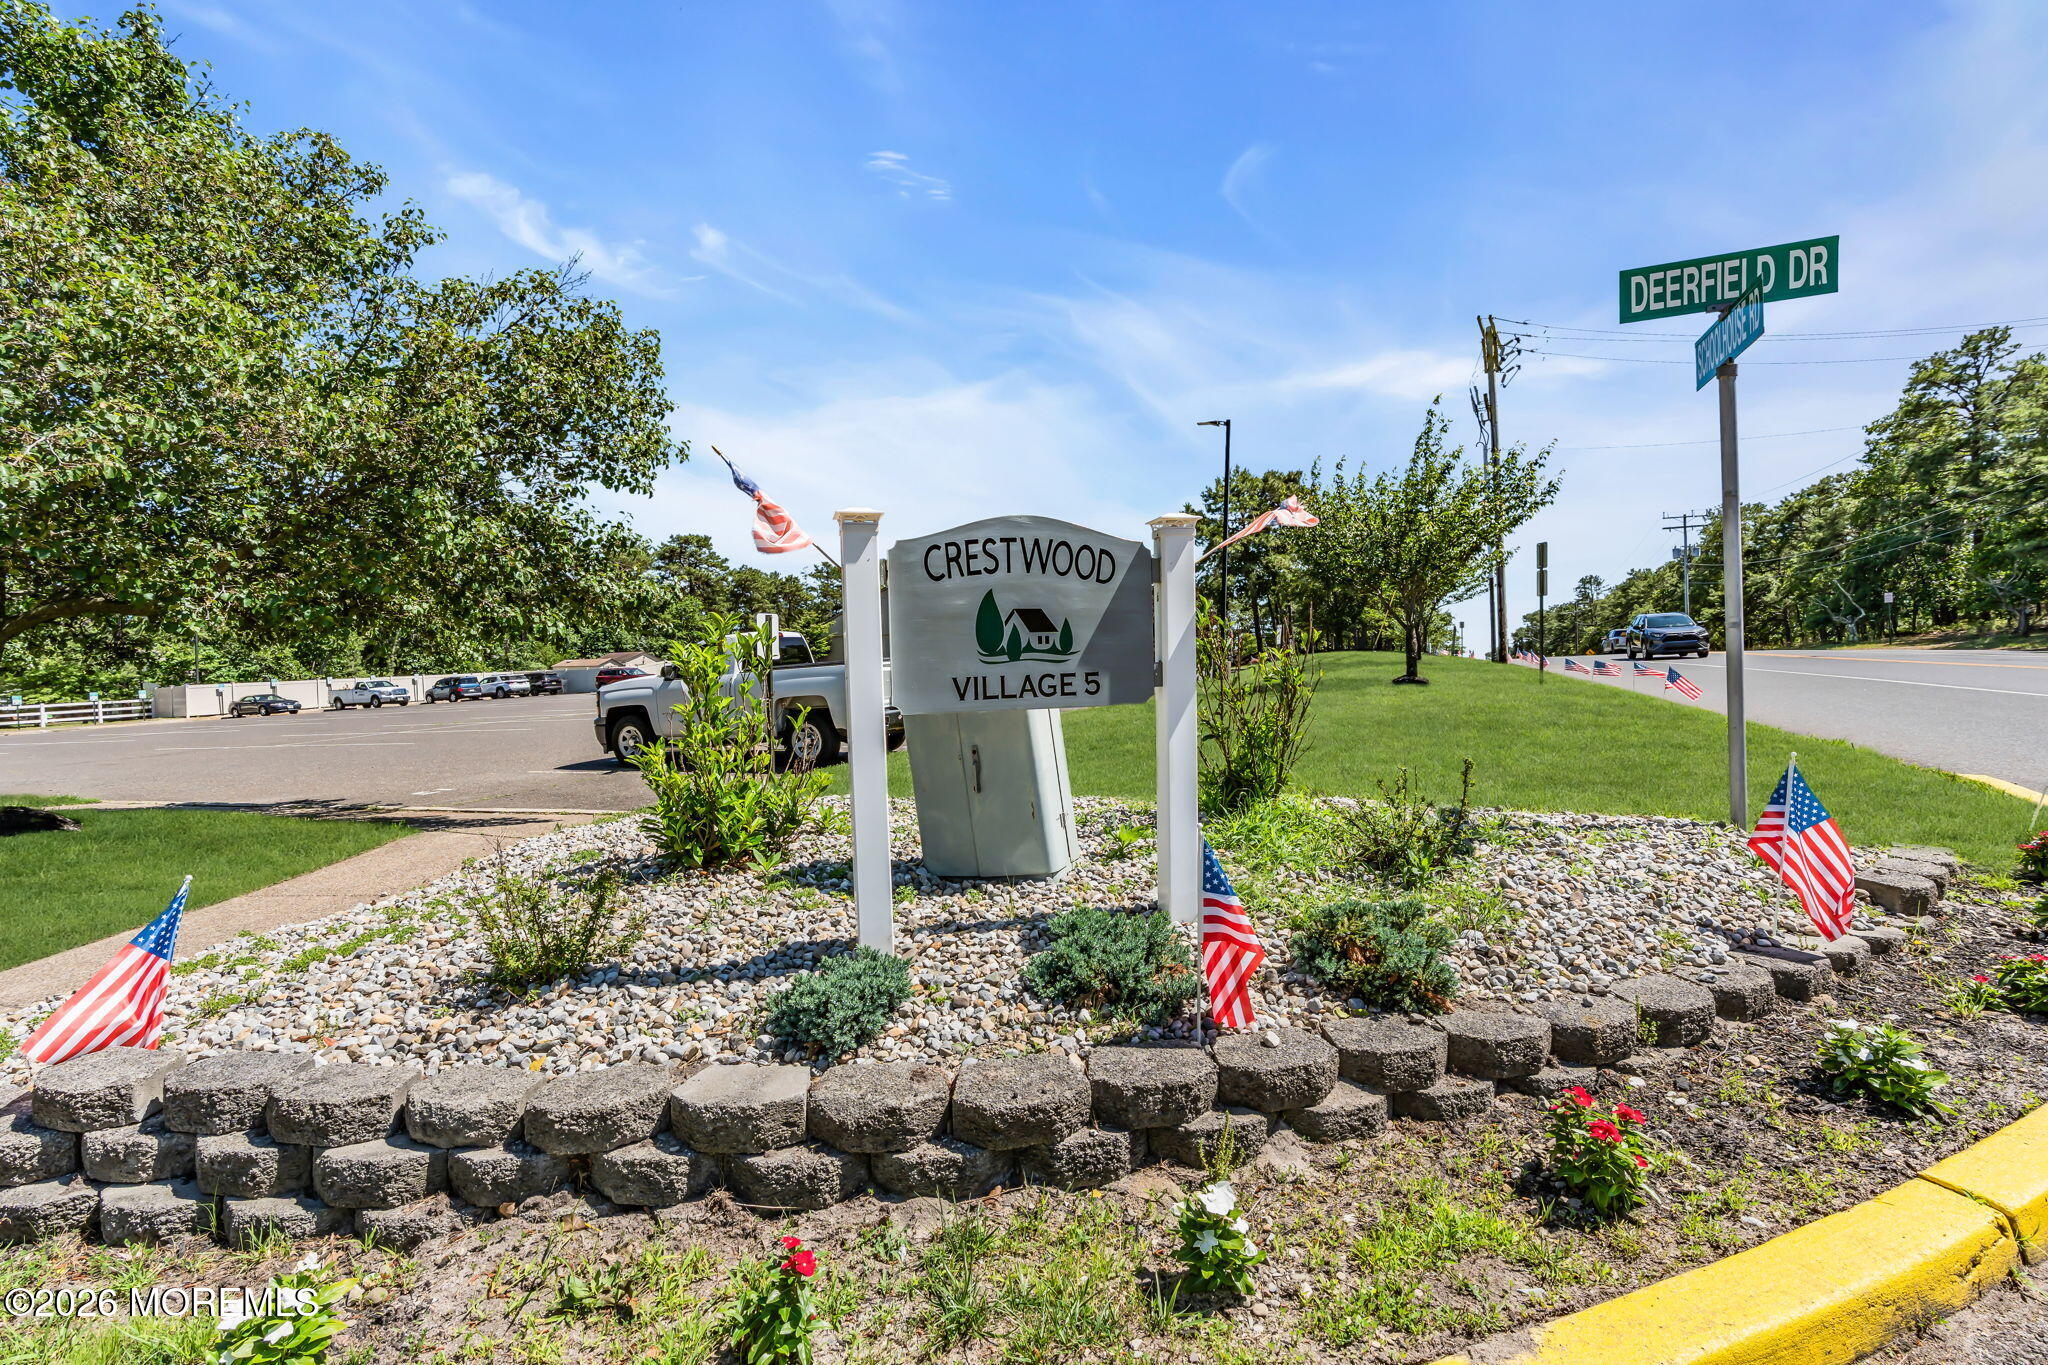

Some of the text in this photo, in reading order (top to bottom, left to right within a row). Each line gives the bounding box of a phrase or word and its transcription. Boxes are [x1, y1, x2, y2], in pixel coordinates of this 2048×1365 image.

[1788, 244, 1828, 290] DR
[1748, 286, 1761, 335] RD
[923, 537, 1116, 585] CRESTWOOD
[951, 671, 1101, 701] VILLAGE 5
